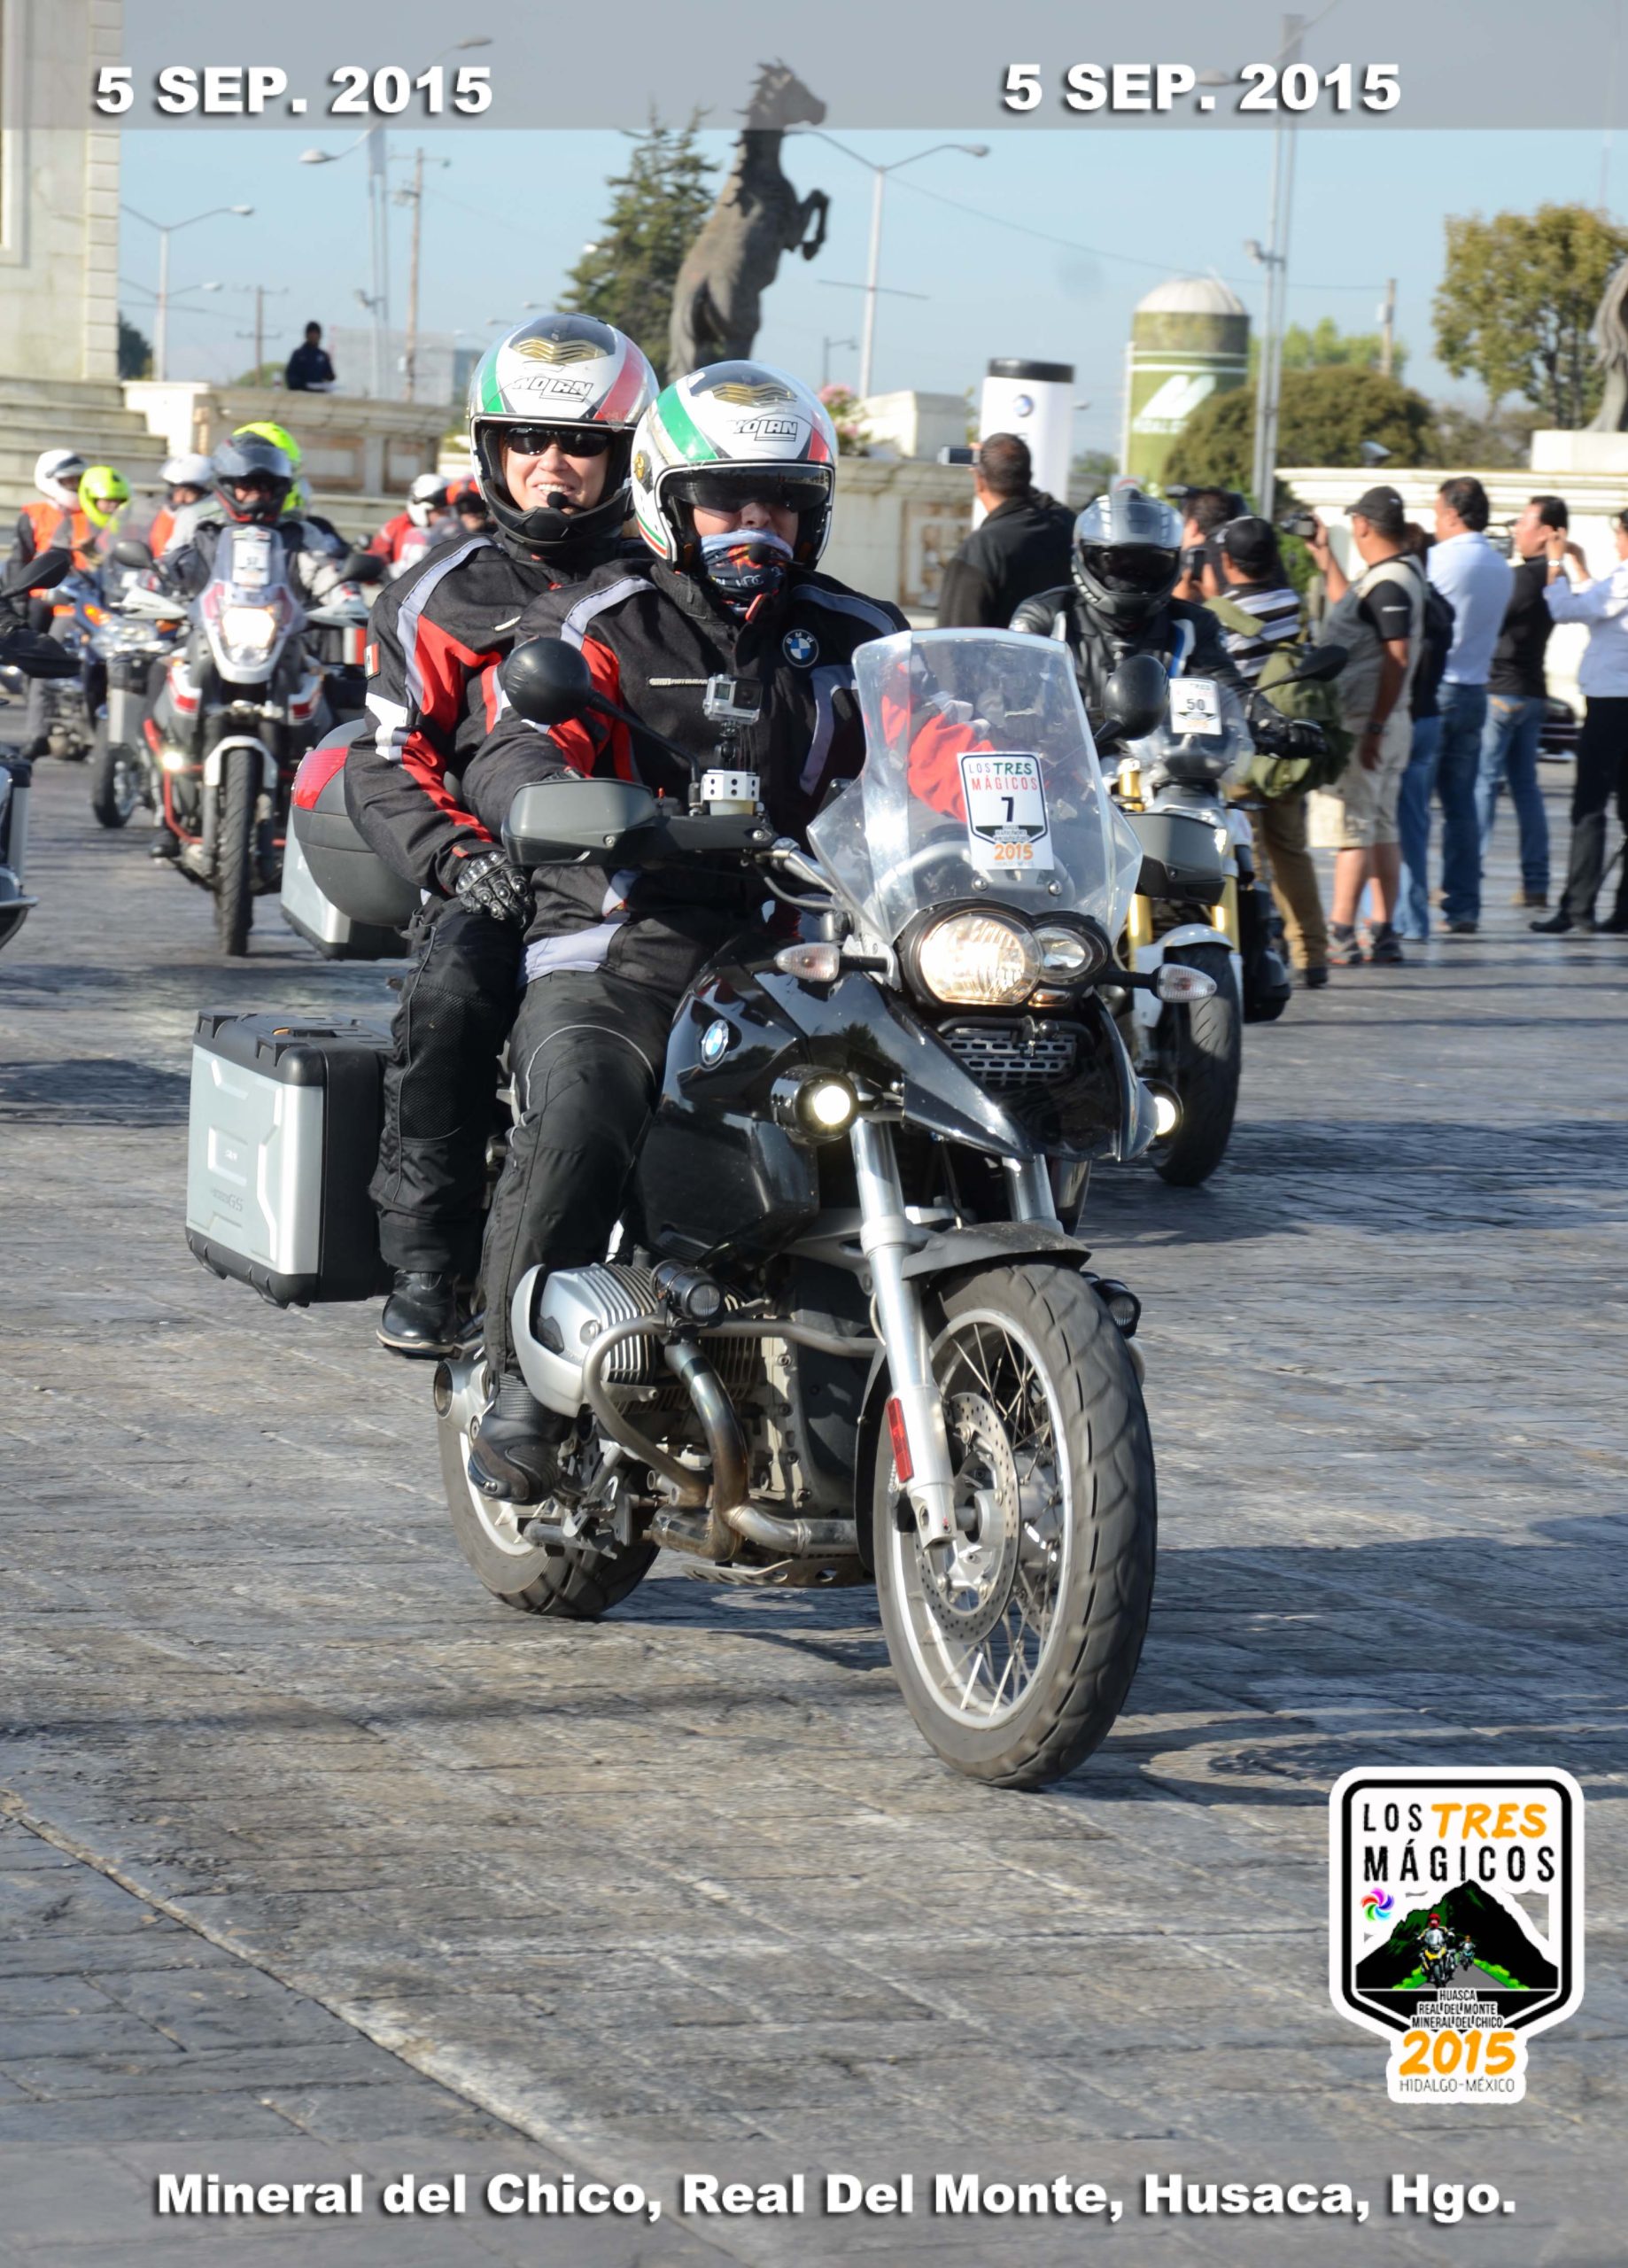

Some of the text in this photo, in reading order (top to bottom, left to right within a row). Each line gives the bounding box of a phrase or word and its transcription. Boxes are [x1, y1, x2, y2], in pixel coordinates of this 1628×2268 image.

[786, 632, 815, 644] BMW
[1186, 698, 1205, 711] 50
[968, 762, 1033, 775] LOS TRES
[971, 775, 1038, 791] MÁGICOS
[1001, 796, 1015, 823] 7
[994, 843, 1034, 861] 2015
